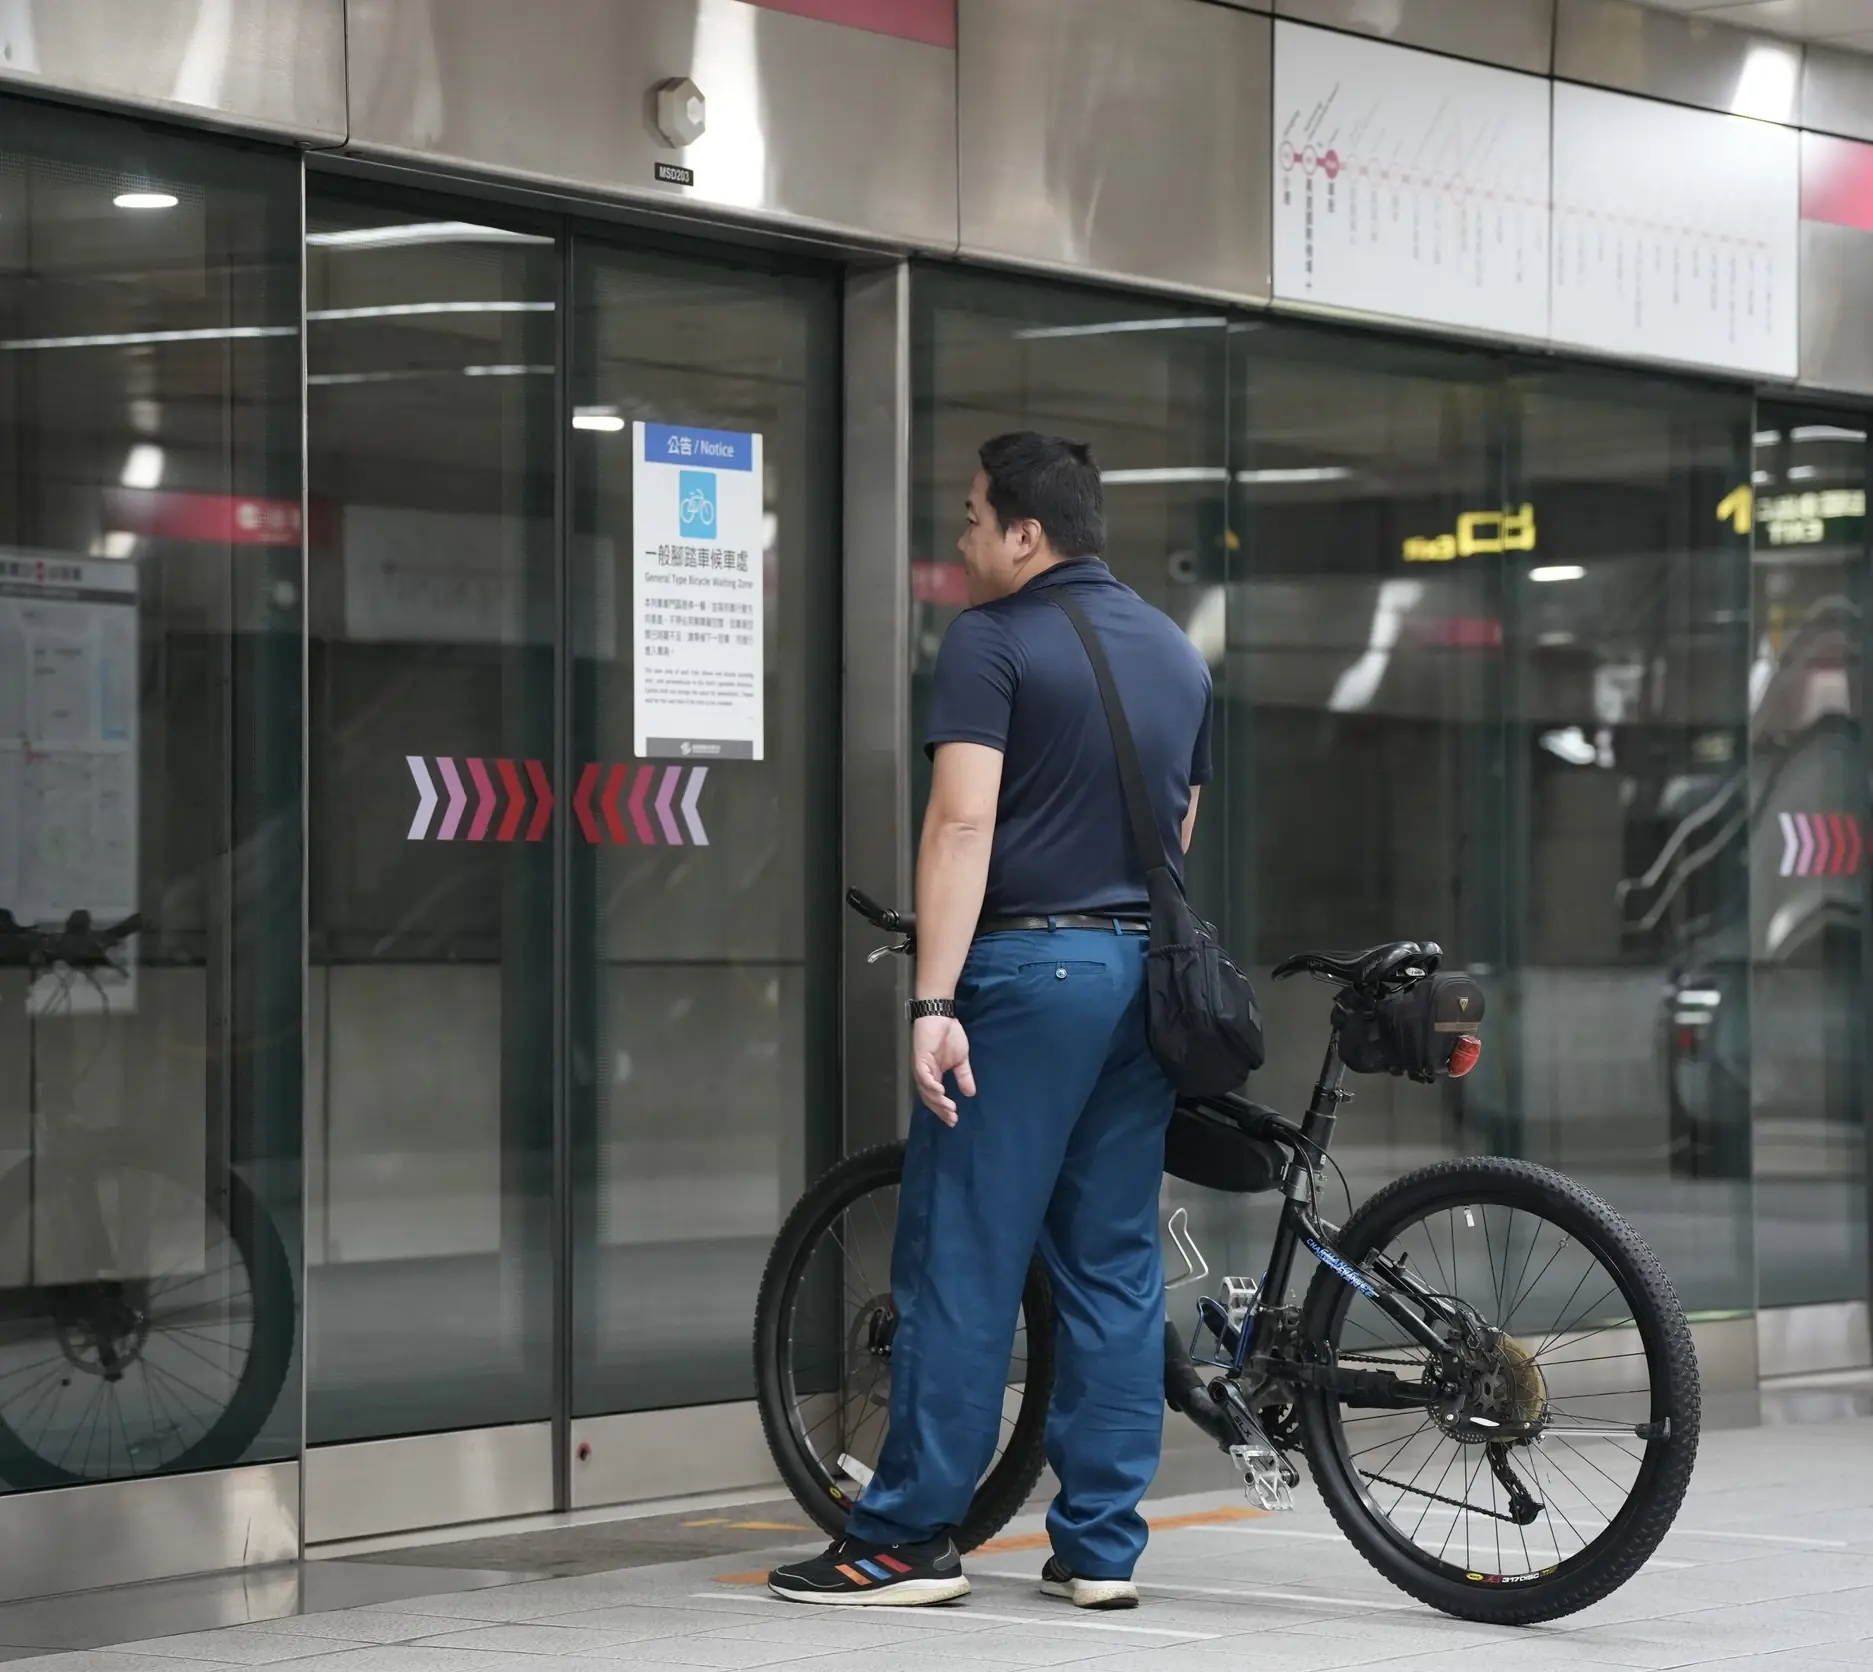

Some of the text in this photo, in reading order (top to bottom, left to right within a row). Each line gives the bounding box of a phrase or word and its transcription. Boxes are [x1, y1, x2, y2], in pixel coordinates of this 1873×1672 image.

[659, 166, 690, 182] MSD203
[667, 435, 692, 457] 公告
[701, 440, 735, 458] Notice
[645, 544, 749, 573] 一般腳踏車候車處
[645, 572, 670, 583] General
[672, 574, 687, 585] Type
[689, 575, 710, 587] Bicycle
[738, 579, 754, 589] Zone
[1234, 1416, 1253, 1438] SLX
